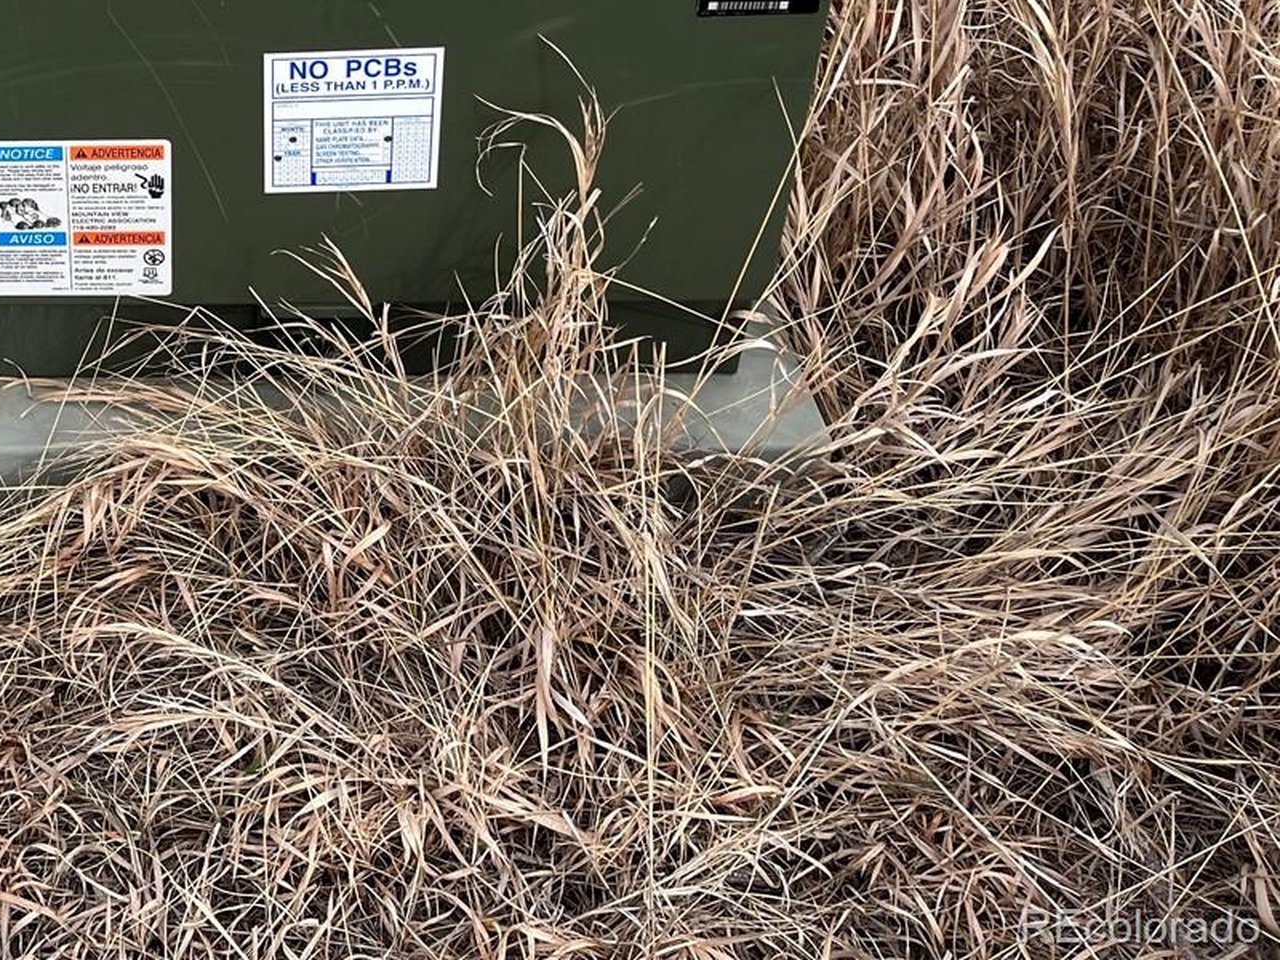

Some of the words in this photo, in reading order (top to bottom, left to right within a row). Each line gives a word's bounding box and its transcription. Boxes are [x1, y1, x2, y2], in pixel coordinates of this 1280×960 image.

[289, 61, 329, 80] NO
[346, 58, 418, 78] PCBs
[276, 82, 320, 94] (LESS
[326, 80, 366, 91] THAN
[383, 78, 431, 90] P.P.M.)
[0, 148, 54, 159] NOTICE
[91, 148, 161, 158] ADVERTENCIA
[104, 164, 148, 172] peligroso
[70, 183, 90, 193] ¡NO
[92, 183, 137, 192] ENTRAR!
[9, 234, 55, 244] AVISO
[94, 234, 161, 244] ADVERTENCIA
